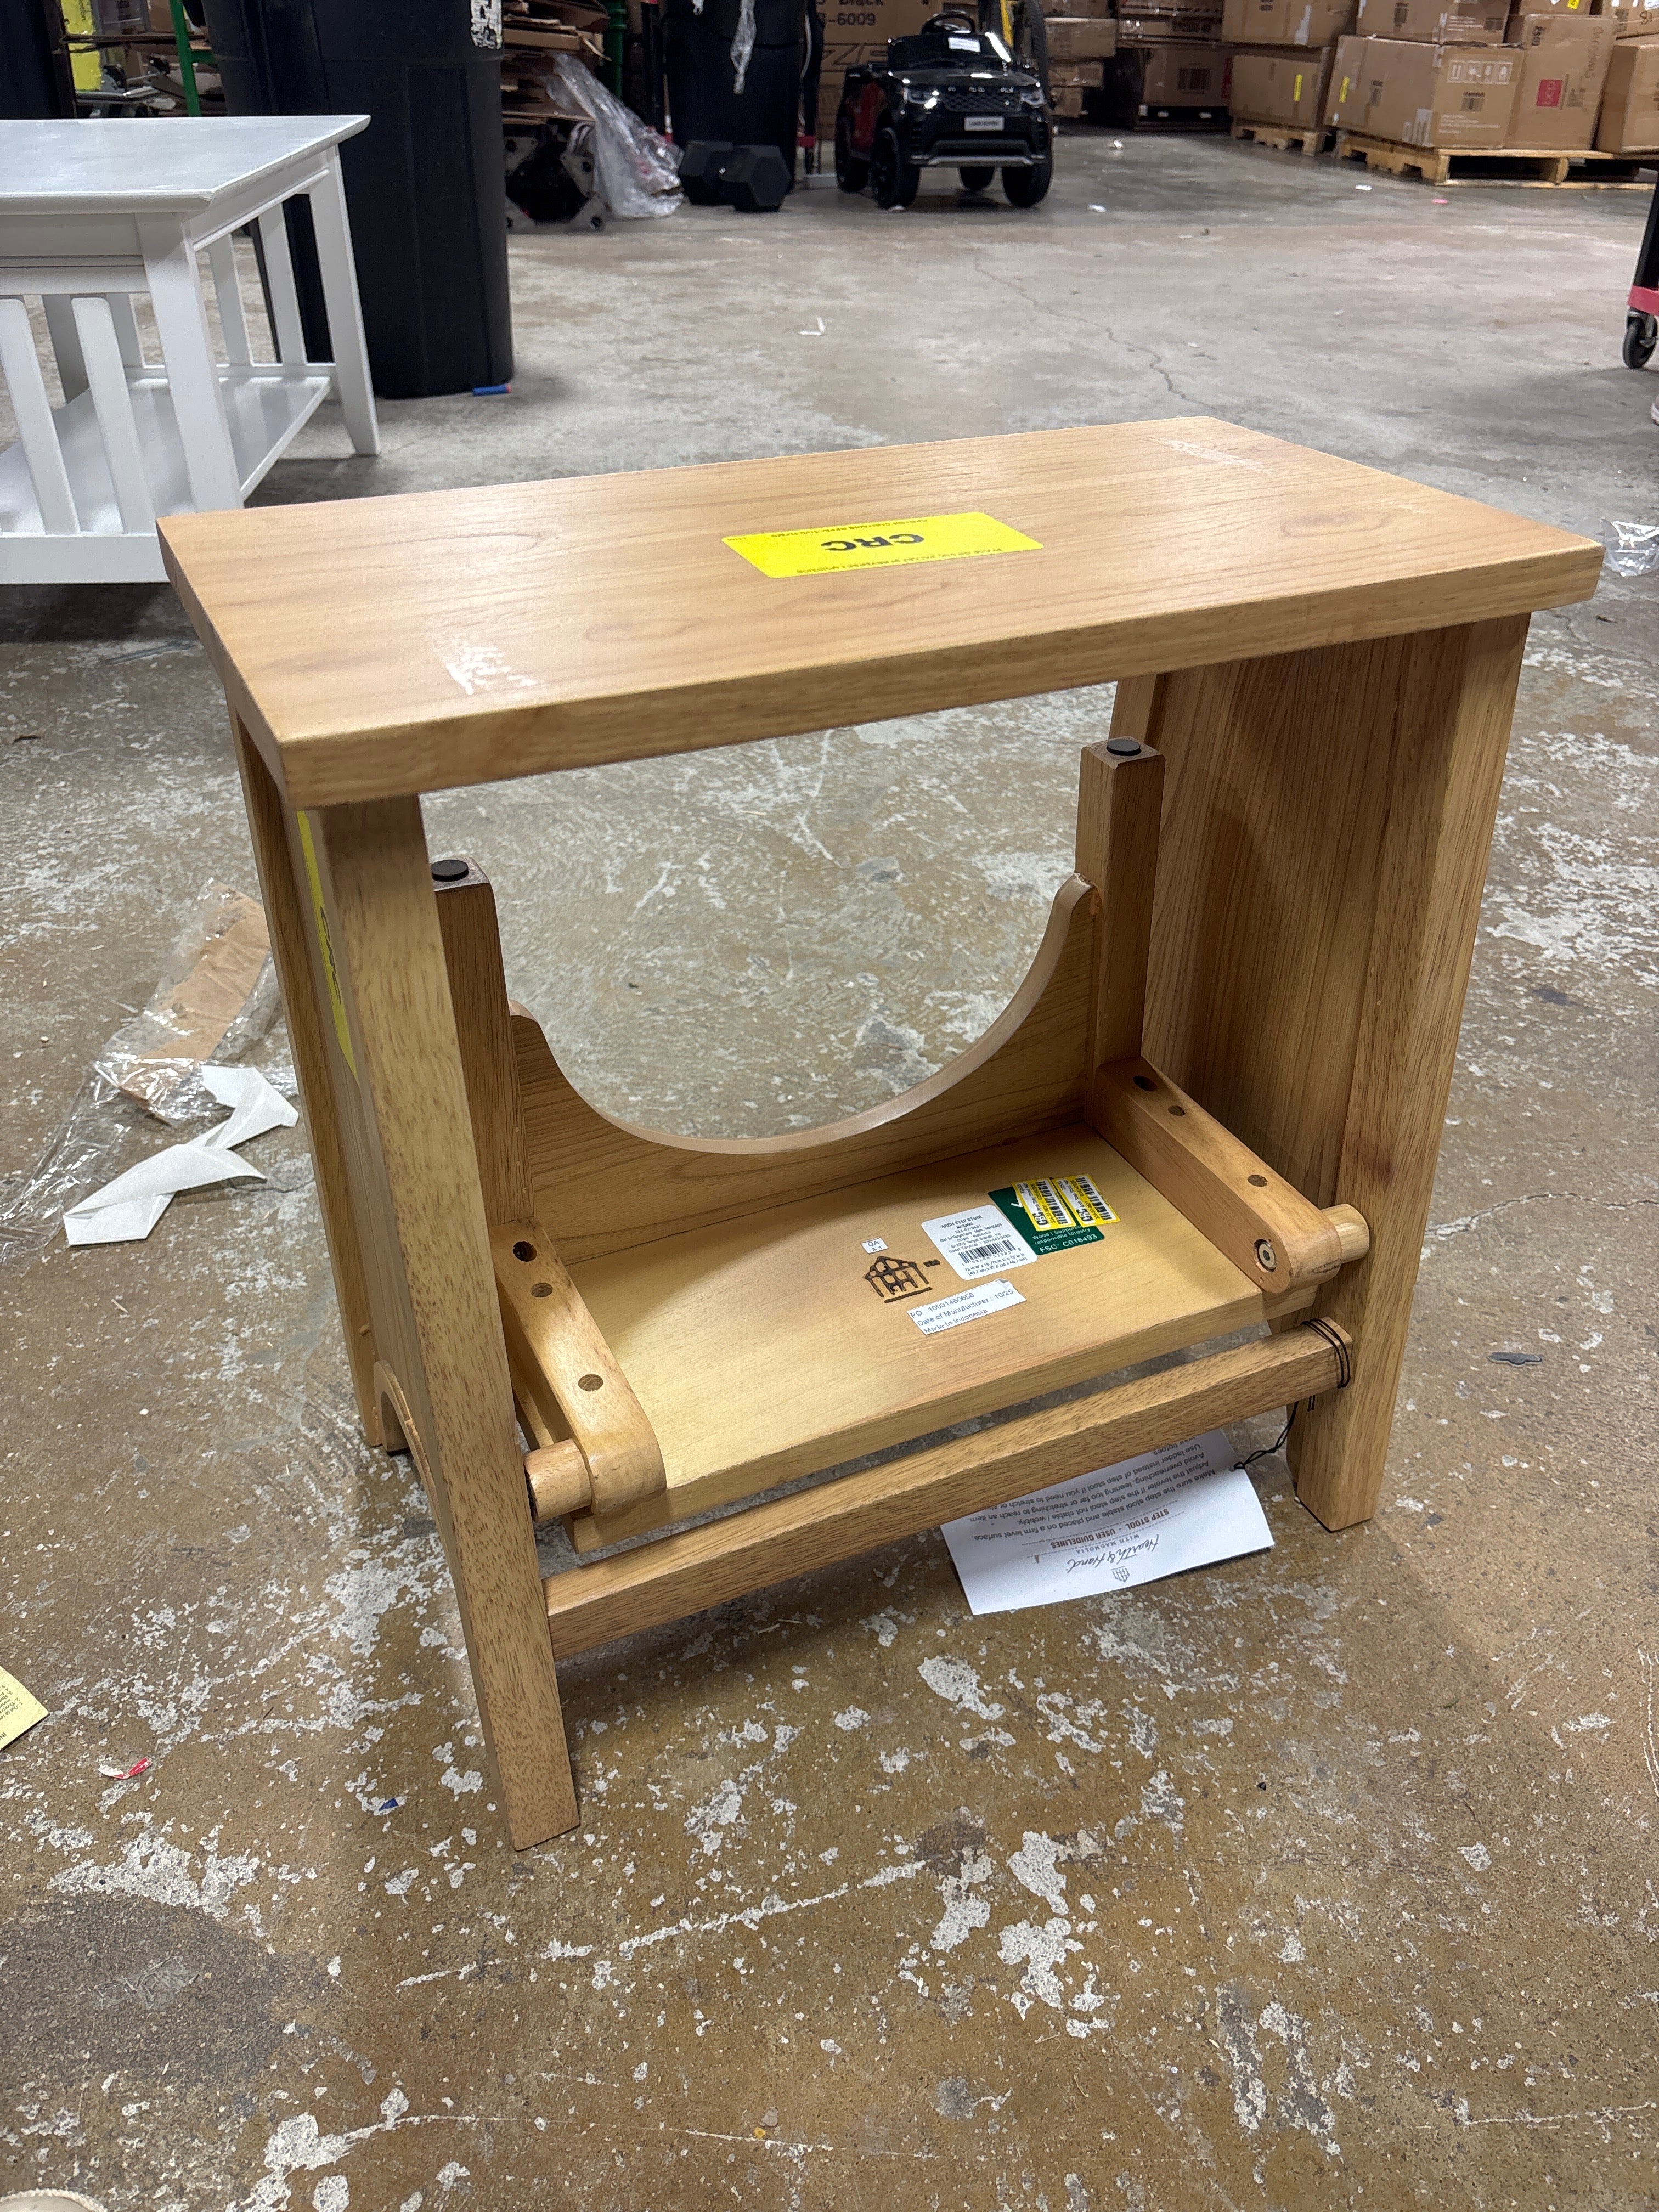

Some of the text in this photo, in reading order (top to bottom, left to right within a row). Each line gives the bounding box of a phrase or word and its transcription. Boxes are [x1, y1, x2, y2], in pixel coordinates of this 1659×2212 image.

[821, 534, 924, 551] CRC
[1032, 1212, 1049, 1226] CRC
[1075, 1208, 1094, 1222] CRC
[1053, 1225, 1084, 1235] Supportin
[1034, 1227, 1091, 1245] responsible forestry
[1062, 1234, 1097, 1246] C016493
[917, 1317, 935, 1326] Date
[943, 1298, 989, 1317] Manufacturer
[994, 1289, 1014, 1299] 10/25
[910, 1310, 923, 1319] PO
[923, 1324, 945, 1334] Made
[953, 1309, 988, 1324] Indonesia
[1185, 1443, 1201, 1453] Use
[1161, 1450, 1186, 1464] ladder
[1183, 1451, 1204, 1465] Avoid
[1130, 1460, 1184, 1484] overreaching,
[1132, 1460, 1161, 1476] instead
[1185, 1460, 1210, 1475] Adjust
[1106, 1474, 1123, 1484] step
[1124, 1471, 1132, 1480] of
[1172, 1470, 1186, 1479] the
[1194, 1468, 1216, 1481] Make
[1086, 1481, 1105, 1492] stool
[1147, 1476, 1172, 1491] leveler
[1176, 1477, 1193, 1488] sure
[1065, 1487, 1080, 1497] you
[1104, 1481, 1133, 1496] leaning
[1126, 1489, 1140, 1498] the
[1162, 1486, 1176, 1494] the
[1045, 1493, 1065, 1503] need
[1091, 1492, 1104, 1500] too
[1109, 1494, 1126, 1504] step
[1145, 1491, 1162, 1502] step
[1008, 1498, 1035, 1508] stretch
[1030, 1502, 1069, 1513] stretching
[1089, 1500, 1108, 1512] stool
[1125, 1498, 1144, 1511] stool
[999, 1510, 1021, 1519] reach
[1051, 1510, 1075, 1520] stable
[1075, 1506, 1089, 1515] not
[1101, 1506, 1125, 1517] stable
[968, 1515, 988, 1523] item.
[1016, 1511, 1046, 1528] wobbly.
[1058, 1516, 1084, 1529] placed
[1085, 1514, 1100, 1523] and
[1003, 1530, 1023, 1538] level
[1050, 1508, 1169, 1549] STEP STOOL USER GUIDELINES
[971, 1532, 1003, 1541] surface.
[1074, 1534, 1139, 1554] WITH MAGNOLIA
[1065, 1533, 1159, 1574] Hearth & Hand
